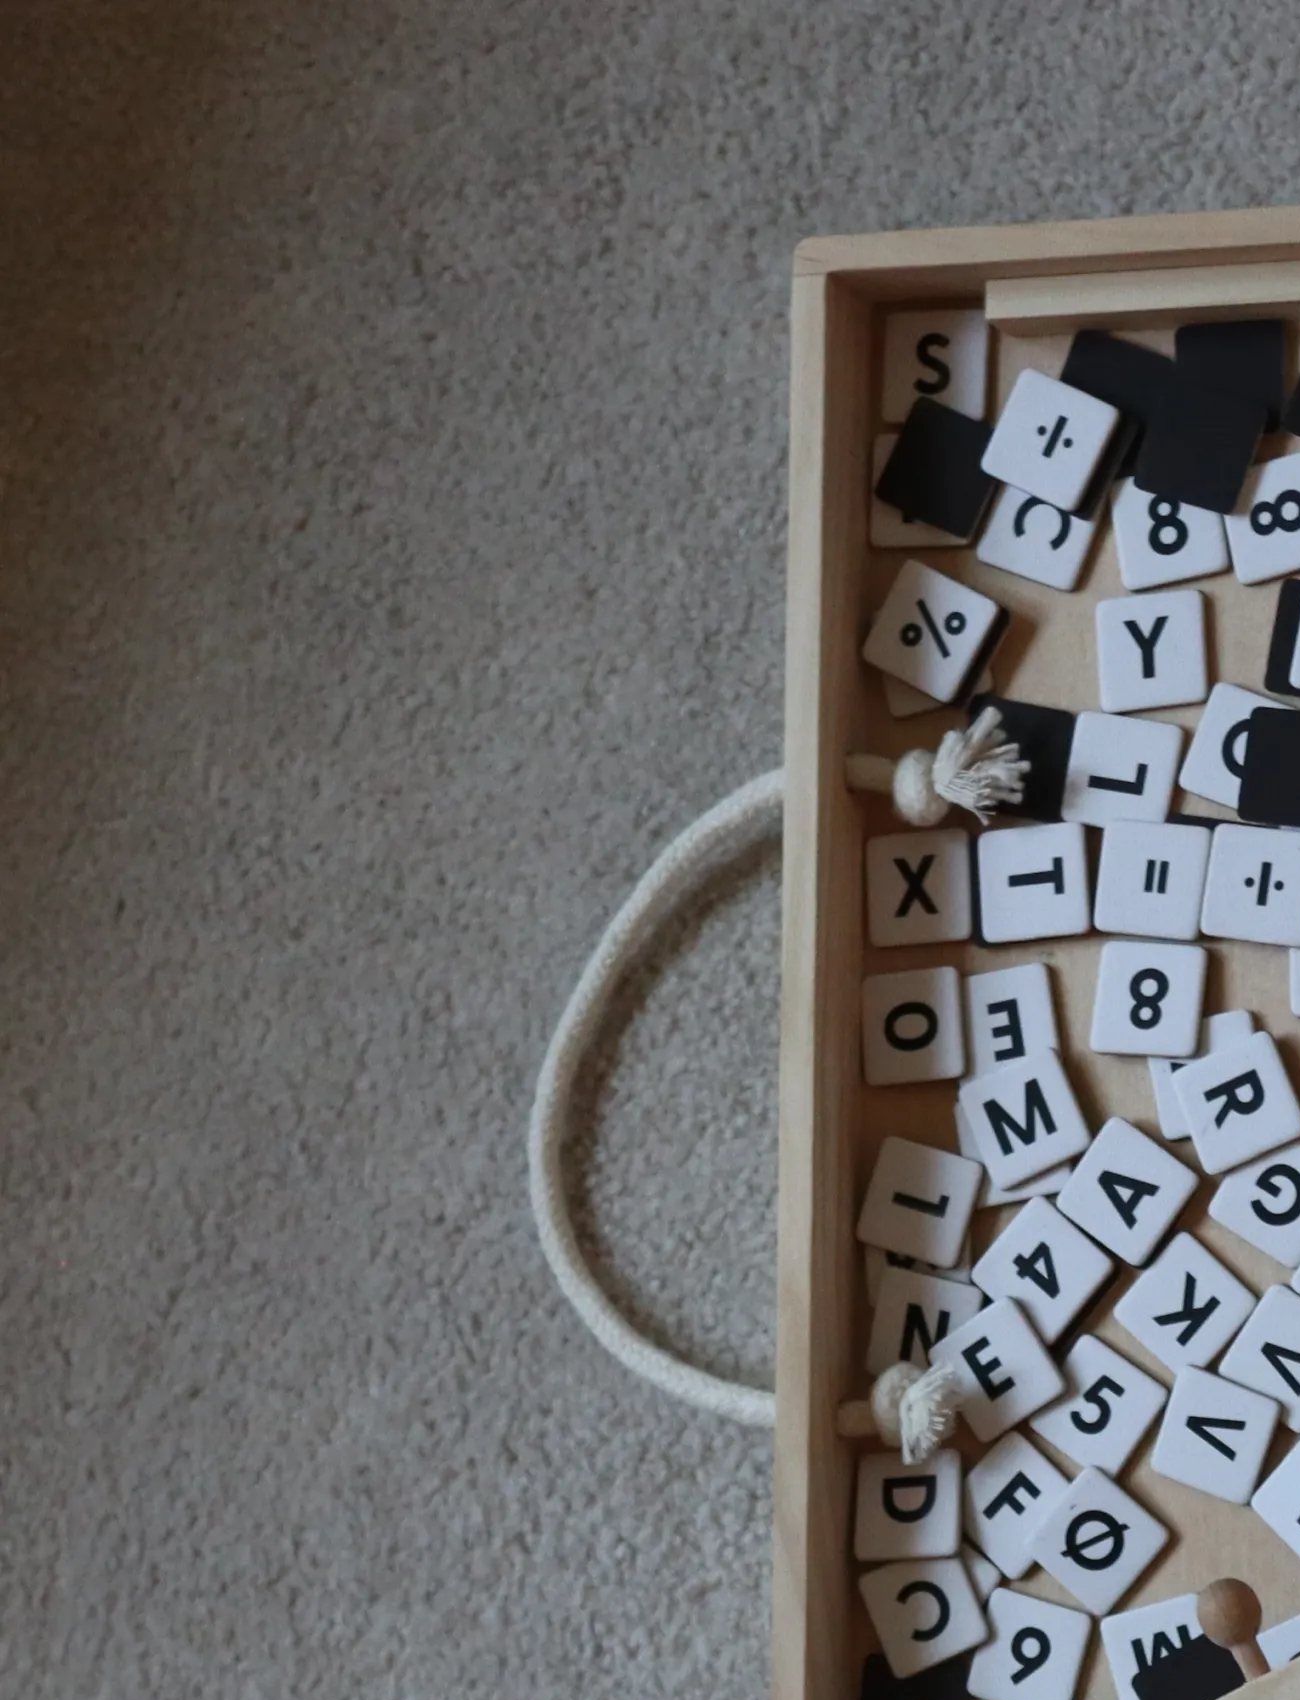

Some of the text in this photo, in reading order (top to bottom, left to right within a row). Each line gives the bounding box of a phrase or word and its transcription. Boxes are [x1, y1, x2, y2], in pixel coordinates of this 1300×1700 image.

[914, 333, 951, 395] S
[1148, 501, 1188, 555] 8
[1124, 616, 1168, 678] Y
[1088, 764, 1147, 795] L
[893, 855, 937, 917] X
[1009, 857, 1064, 894] T
[1130, 968, 1168, 1029] 8
[987, 999, 1025, 1061] E
[983, 1079, 1056, 1155] M
[1204, 1069, 1264, 1128] R
[891, 1190, 949, 1217] L
[1098, 1171, 1159, 1229] A
[1014, 1242, 1059, 1298] 4
[1154, 1272, 1220, 1346] K
[961, 1336, 1015, 1400] E
[1070, 1375, 1125, 1435] 5
[1186, 1416, 1245, 1460] V
[882, 1475, 937, 1523] D
[983, 1472, 1040, 1519] F
[896, 1580, 950, 1642] C
